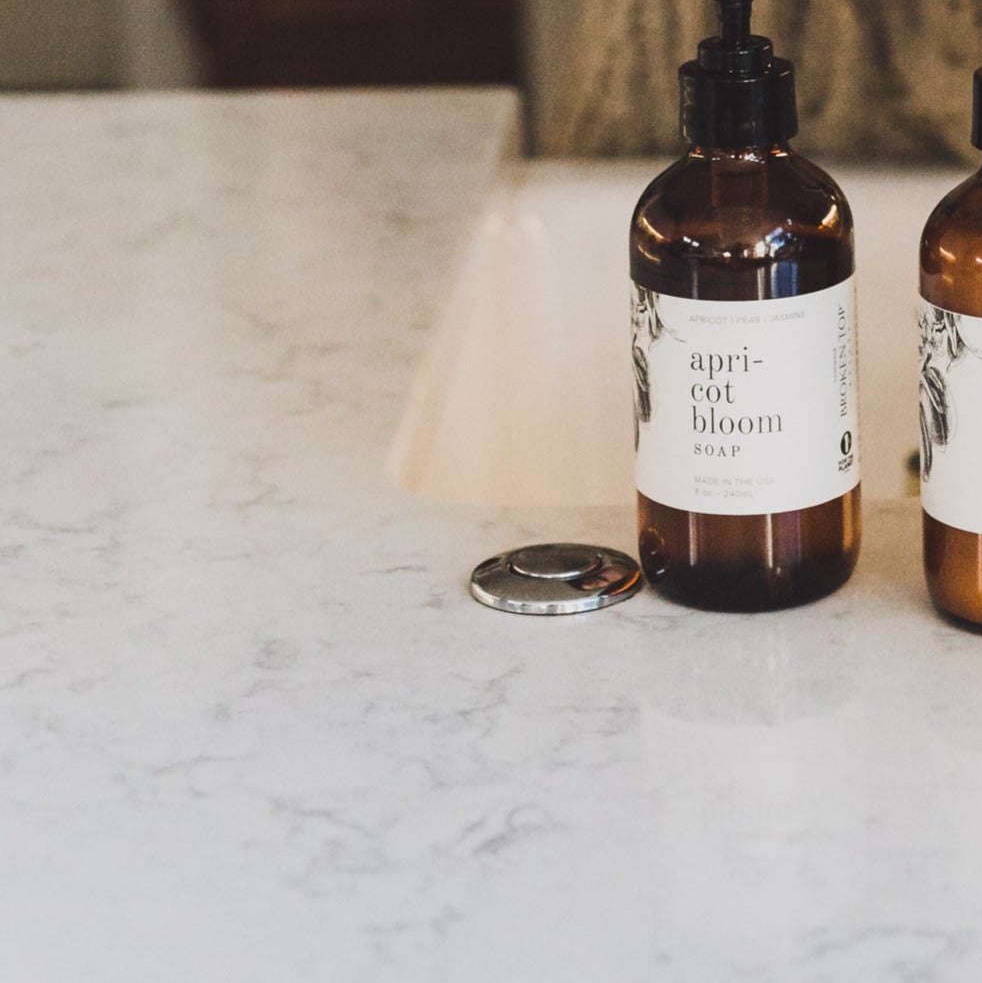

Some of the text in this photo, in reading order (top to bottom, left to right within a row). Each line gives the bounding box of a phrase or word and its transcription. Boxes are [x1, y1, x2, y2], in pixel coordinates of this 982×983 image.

[690, 346, 763, 380] apri-
[691, 380, 735, 404] cot
[692, 405, 783, 435] bloom
[694, 443, 741, 458] SOAP
